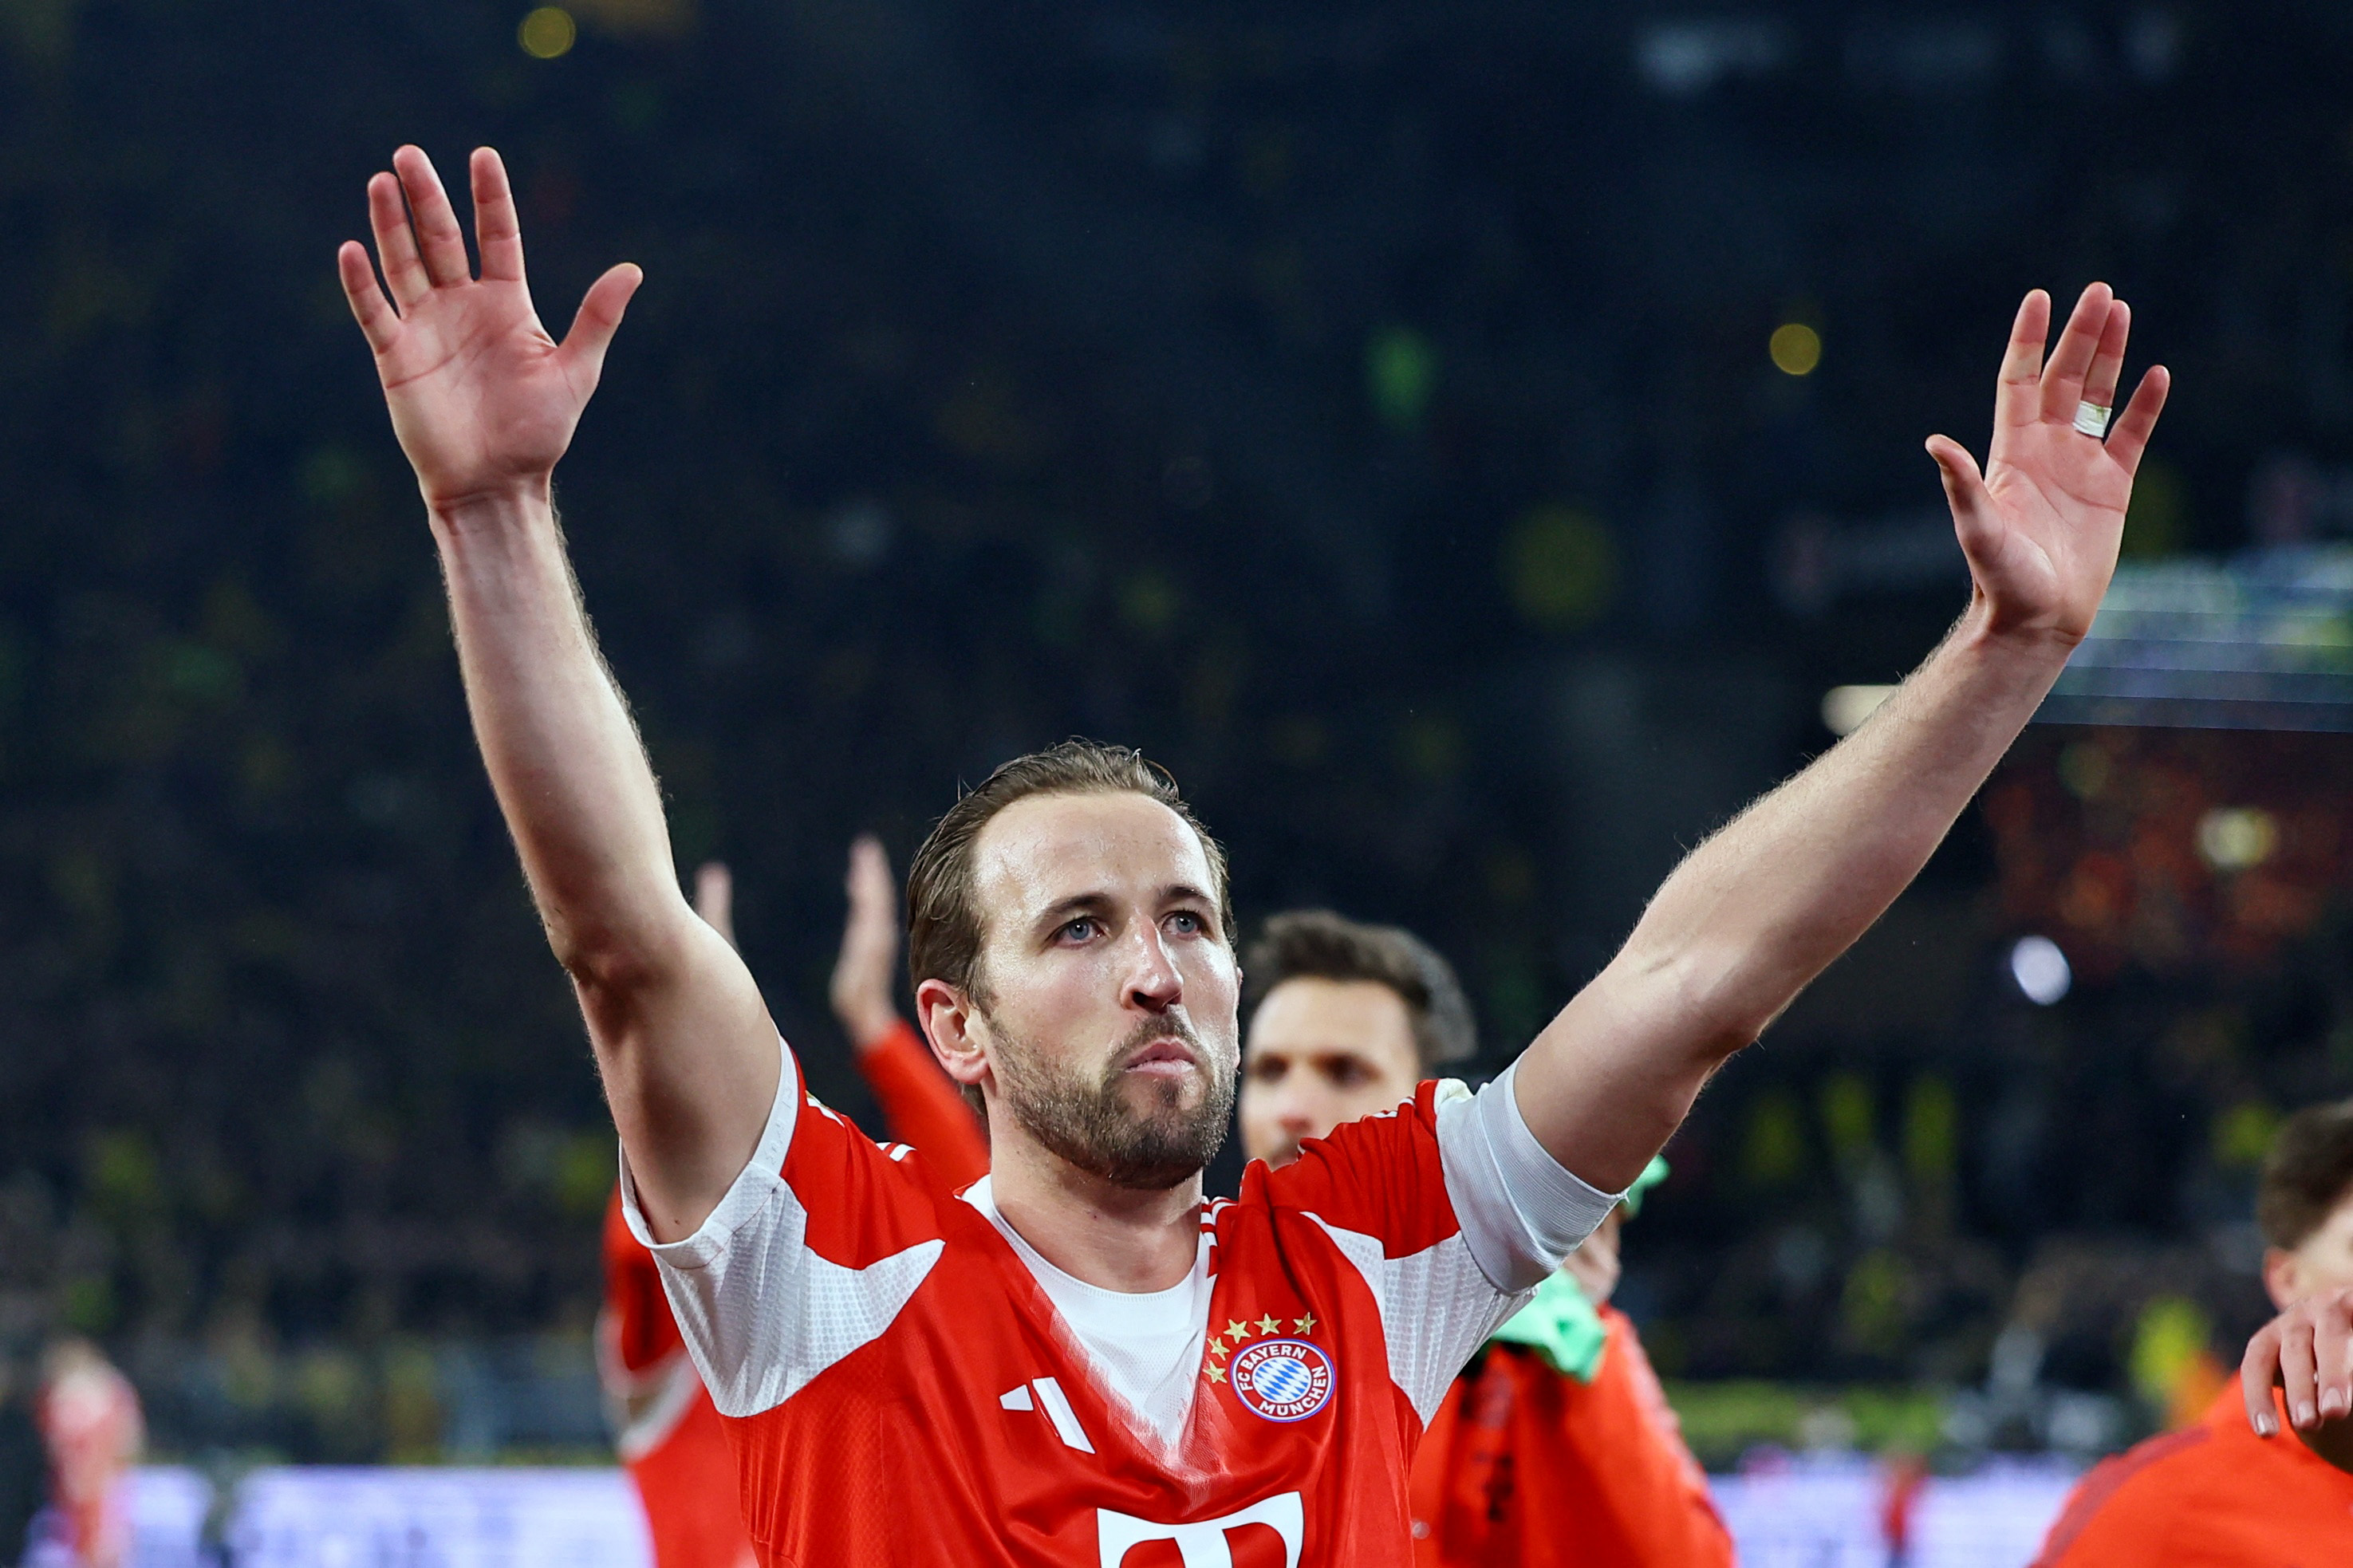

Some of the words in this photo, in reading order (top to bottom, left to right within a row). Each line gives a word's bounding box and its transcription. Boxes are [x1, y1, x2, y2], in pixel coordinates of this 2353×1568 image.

[1240, 1345, 1307, 1370] BAYERN
[1237, 1372, 1253, 1391] FC
[1259, 1365, 1326, 1416] MÜNCHEN
